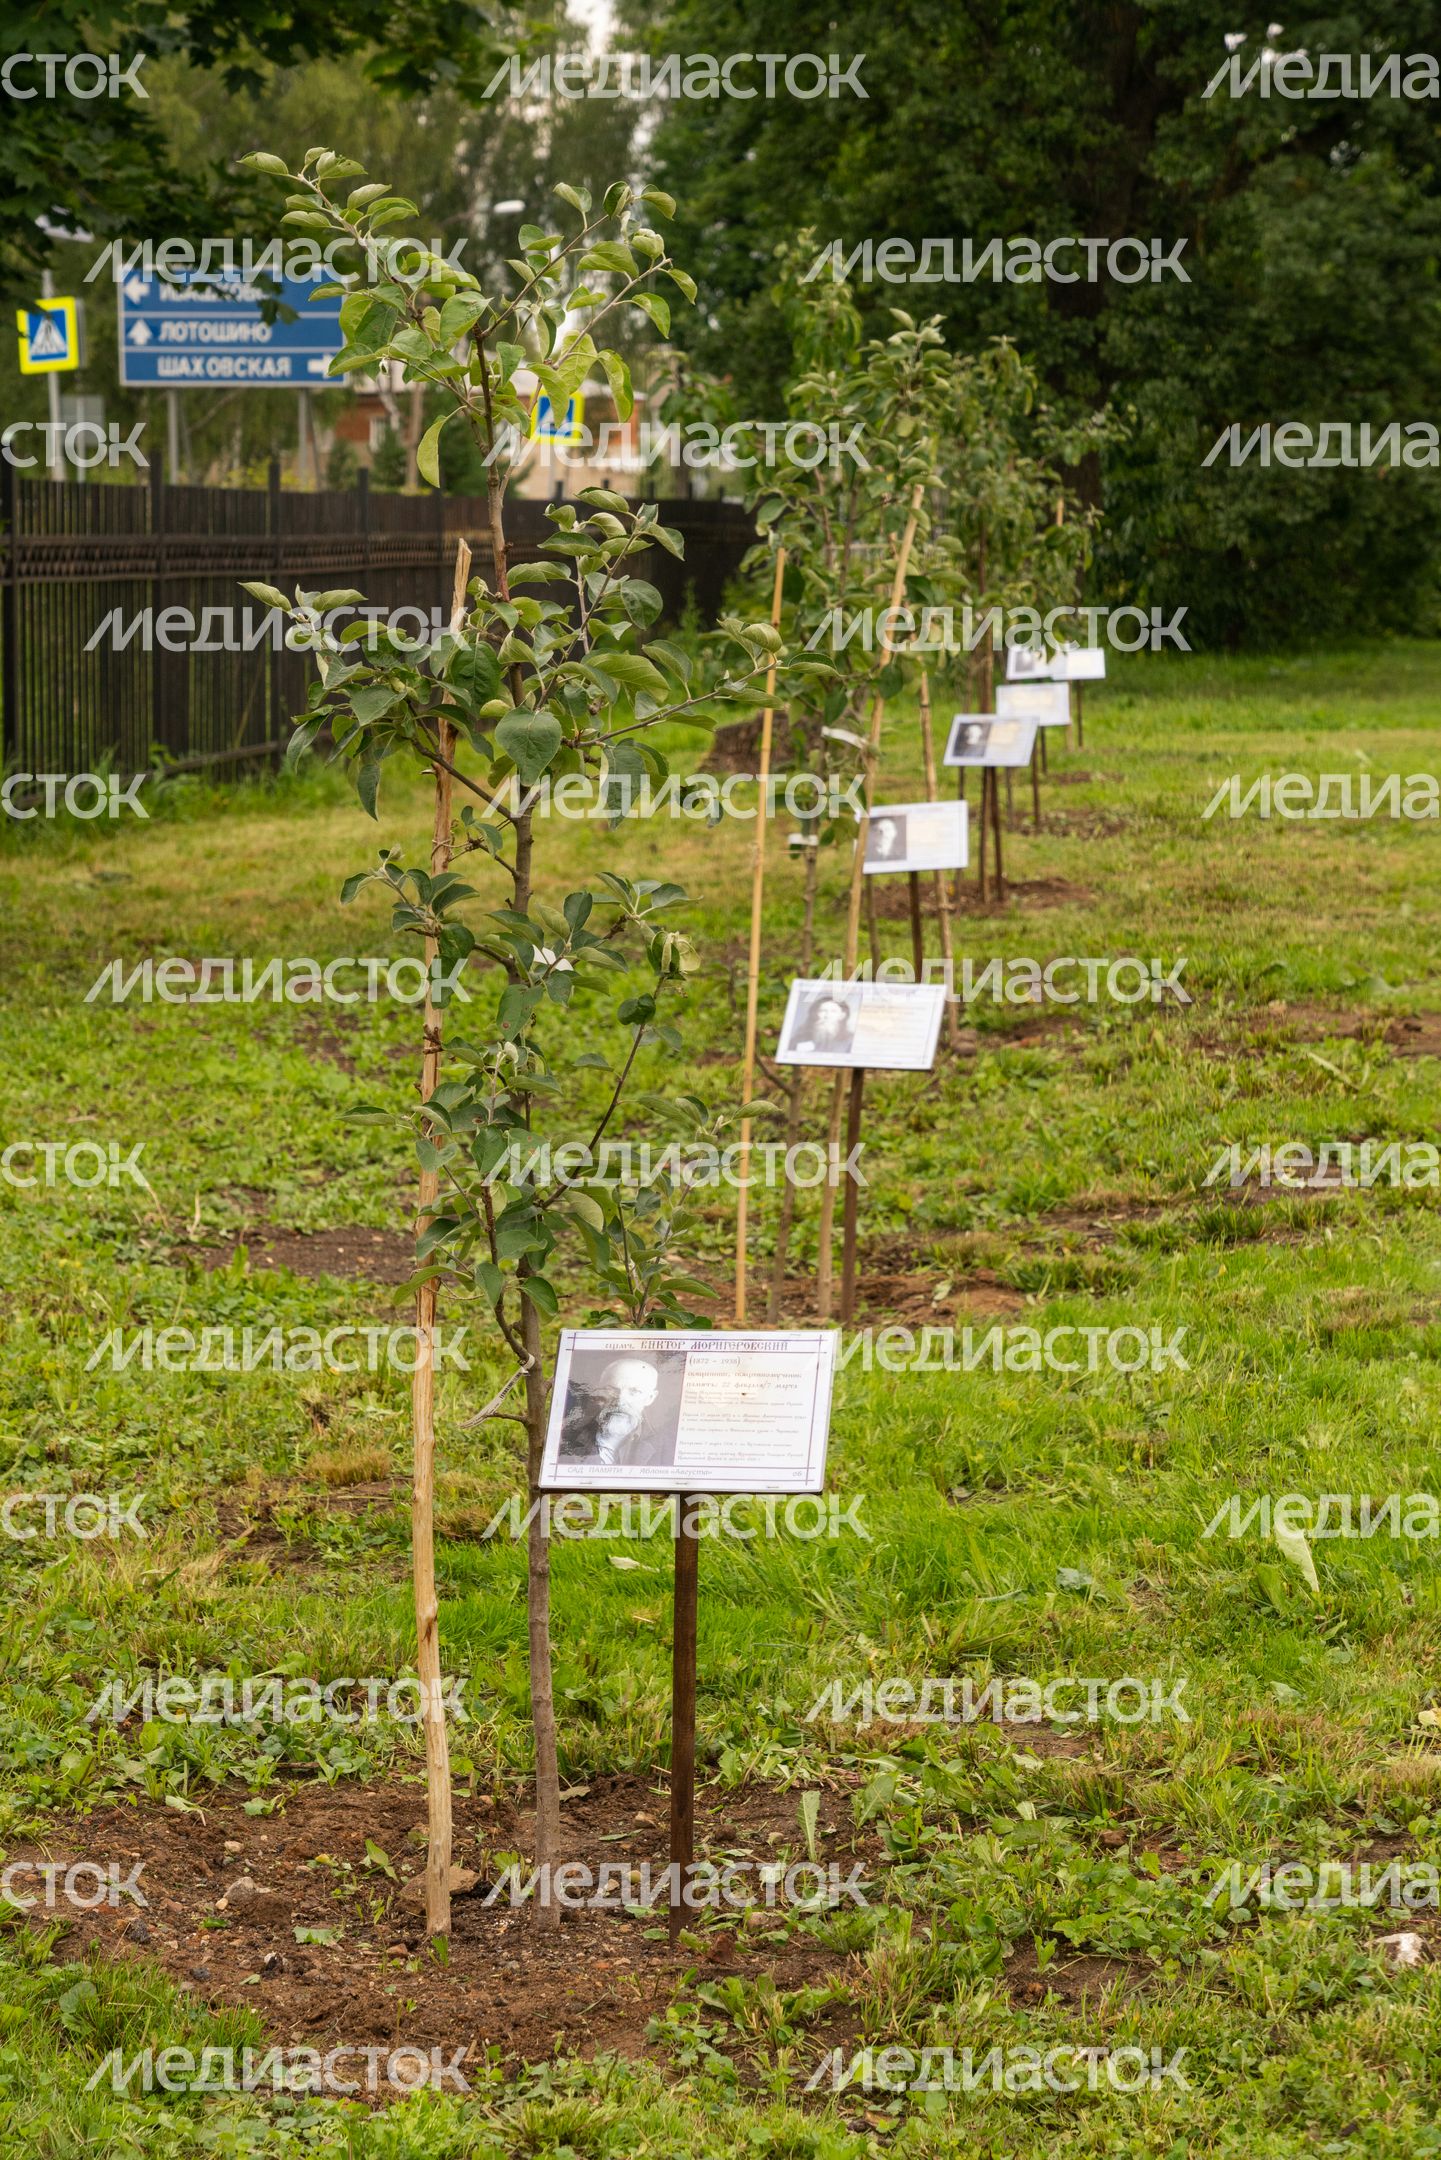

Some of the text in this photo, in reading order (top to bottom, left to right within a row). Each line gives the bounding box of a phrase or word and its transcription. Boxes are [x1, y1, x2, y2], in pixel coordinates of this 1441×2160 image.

[159, 321, 273, 343] ЛОТОШИНО
[157, 356, 292, 378] ШАХОВСКАЯ
[588, 1466, 623, 1475] ПАМЯТИ
